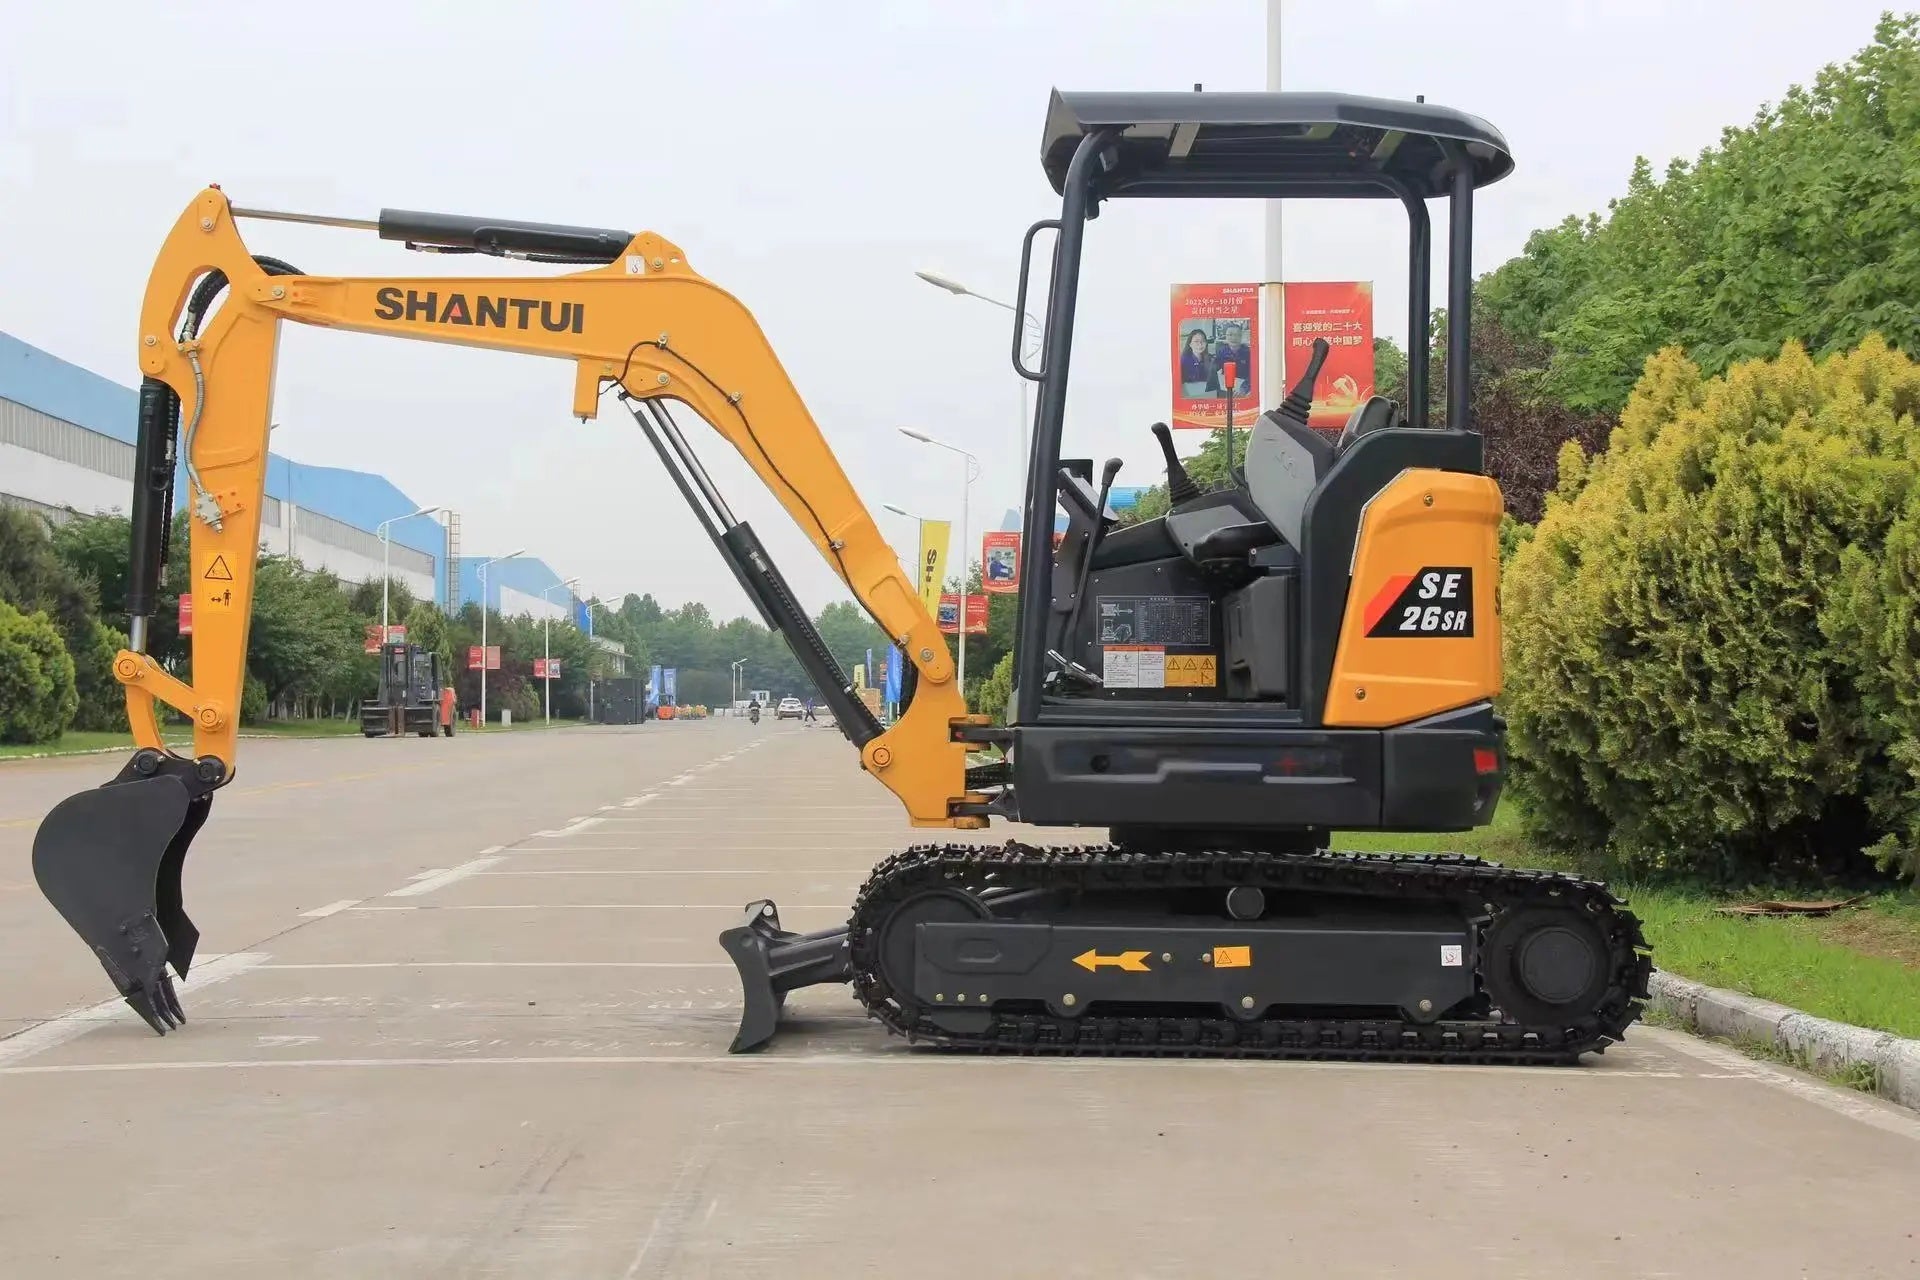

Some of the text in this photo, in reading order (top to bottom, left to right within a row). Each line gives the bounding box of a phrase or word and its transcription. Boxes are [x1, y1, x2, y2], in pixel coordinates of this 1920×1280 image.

[374, 287, 585, 334] SHANTUI
[1292, 321, 1363, 333] 喜迎党的二十大
[1292, 335, 1363, 347] 同心筑中国梦
[1418, 572, 1462, 599] SE
[1399, 606, 1468, 631] 26SR
